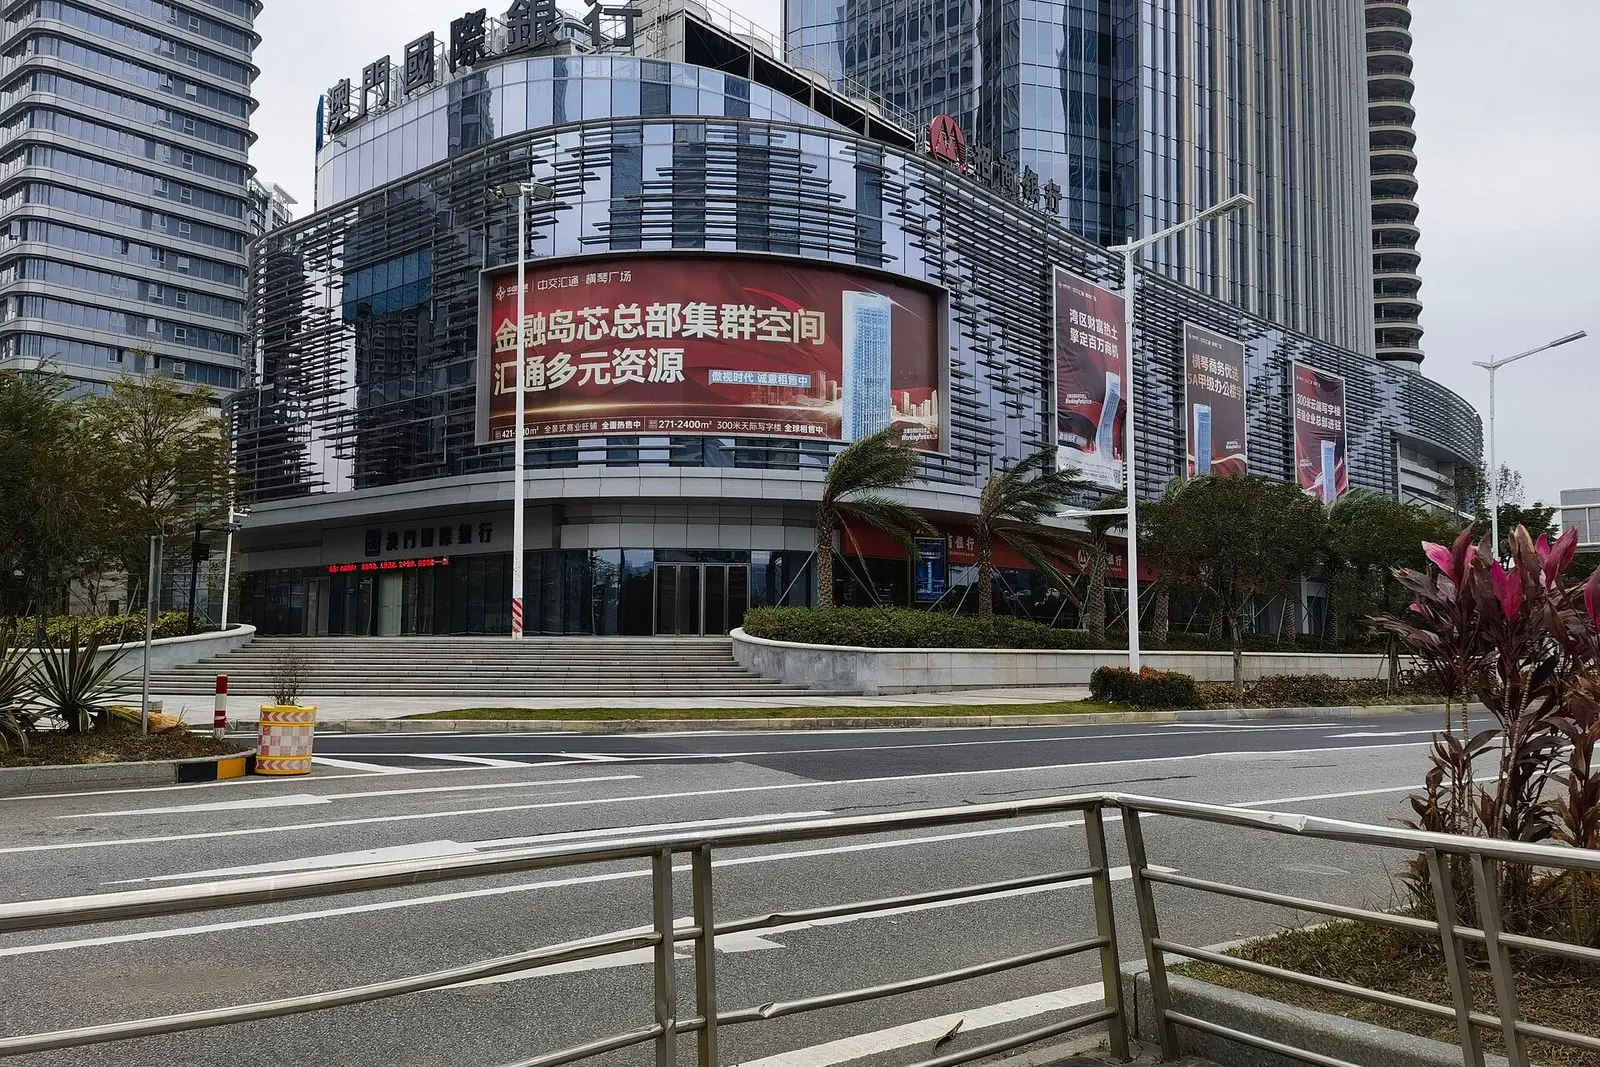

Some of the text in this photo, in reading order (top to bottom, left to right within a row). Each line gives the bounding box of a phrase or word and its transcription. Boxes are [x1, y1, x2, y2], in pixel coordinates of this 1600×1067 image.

[326, 0, 643, 135] 澳門國際銀行
[537, 270, 631, 291] 中交汇通 横琴广场
[495, 302, 826, 353] 金融岛芯总部集群空间
[1069, 308, 1118, 340] 湾区财富热土
[494, 347, 685, 396] 汇通多元资源
